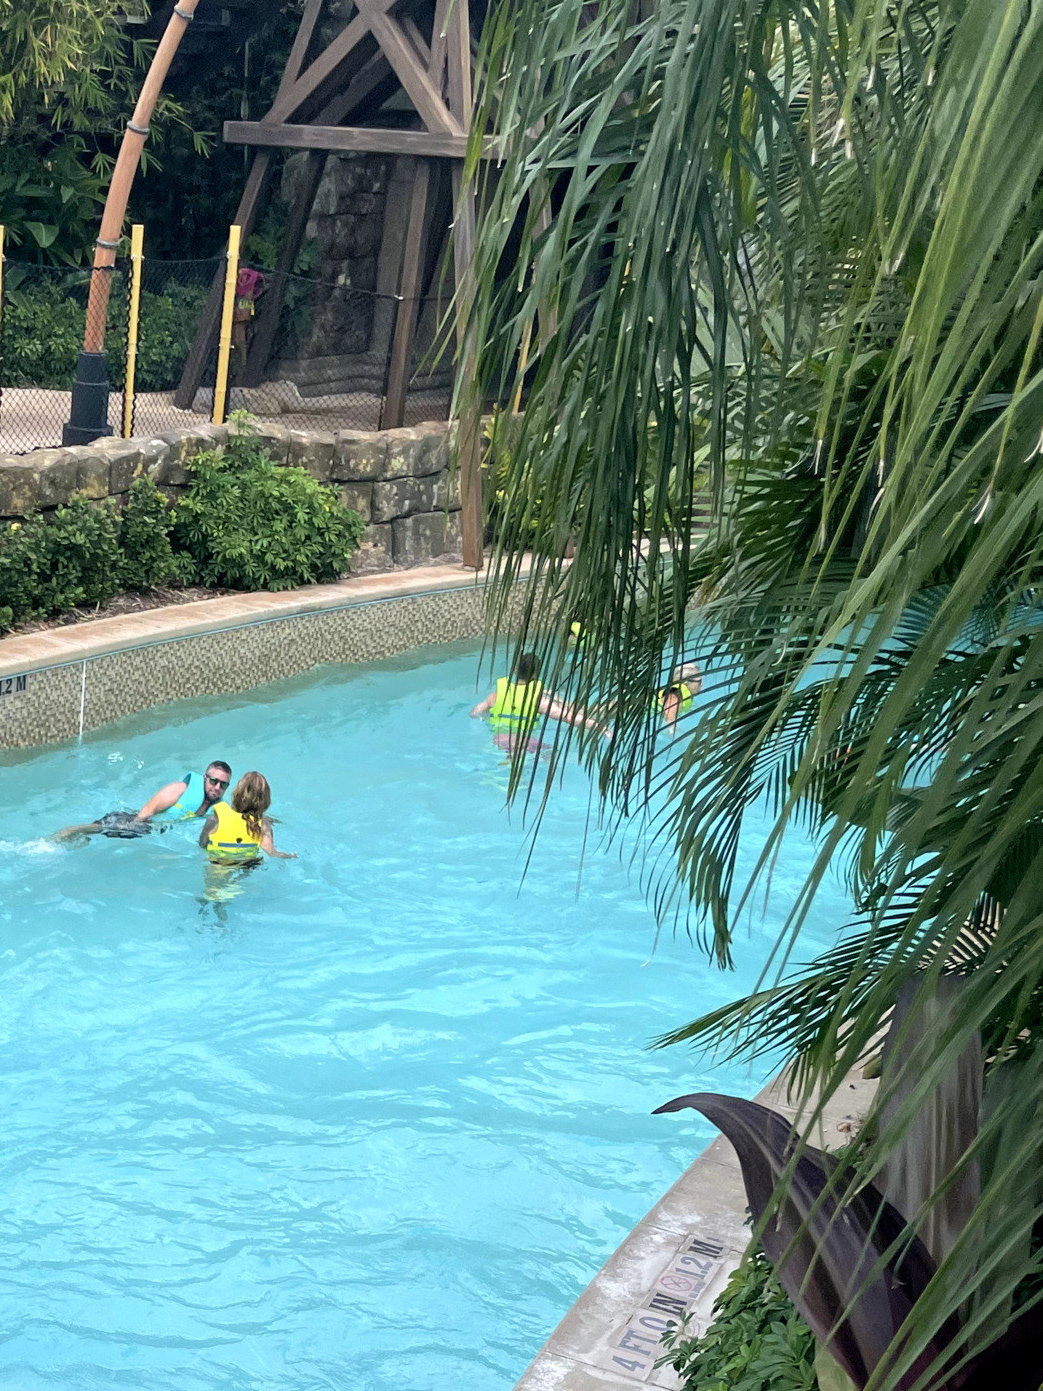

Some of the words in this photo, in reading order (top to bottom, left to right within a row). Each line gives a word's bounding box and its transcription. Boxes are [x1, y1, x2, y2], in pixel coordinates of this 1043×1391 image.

[16, 674, 27, 692] M
[687, 1238, 724, 1260] M
[675, 1256, 714, 1280] 1.2
[648, 1292, 688, 1316] IN
[618, 1329, 658, 1357] FT
[612, 1355, 646, 1372] 4
